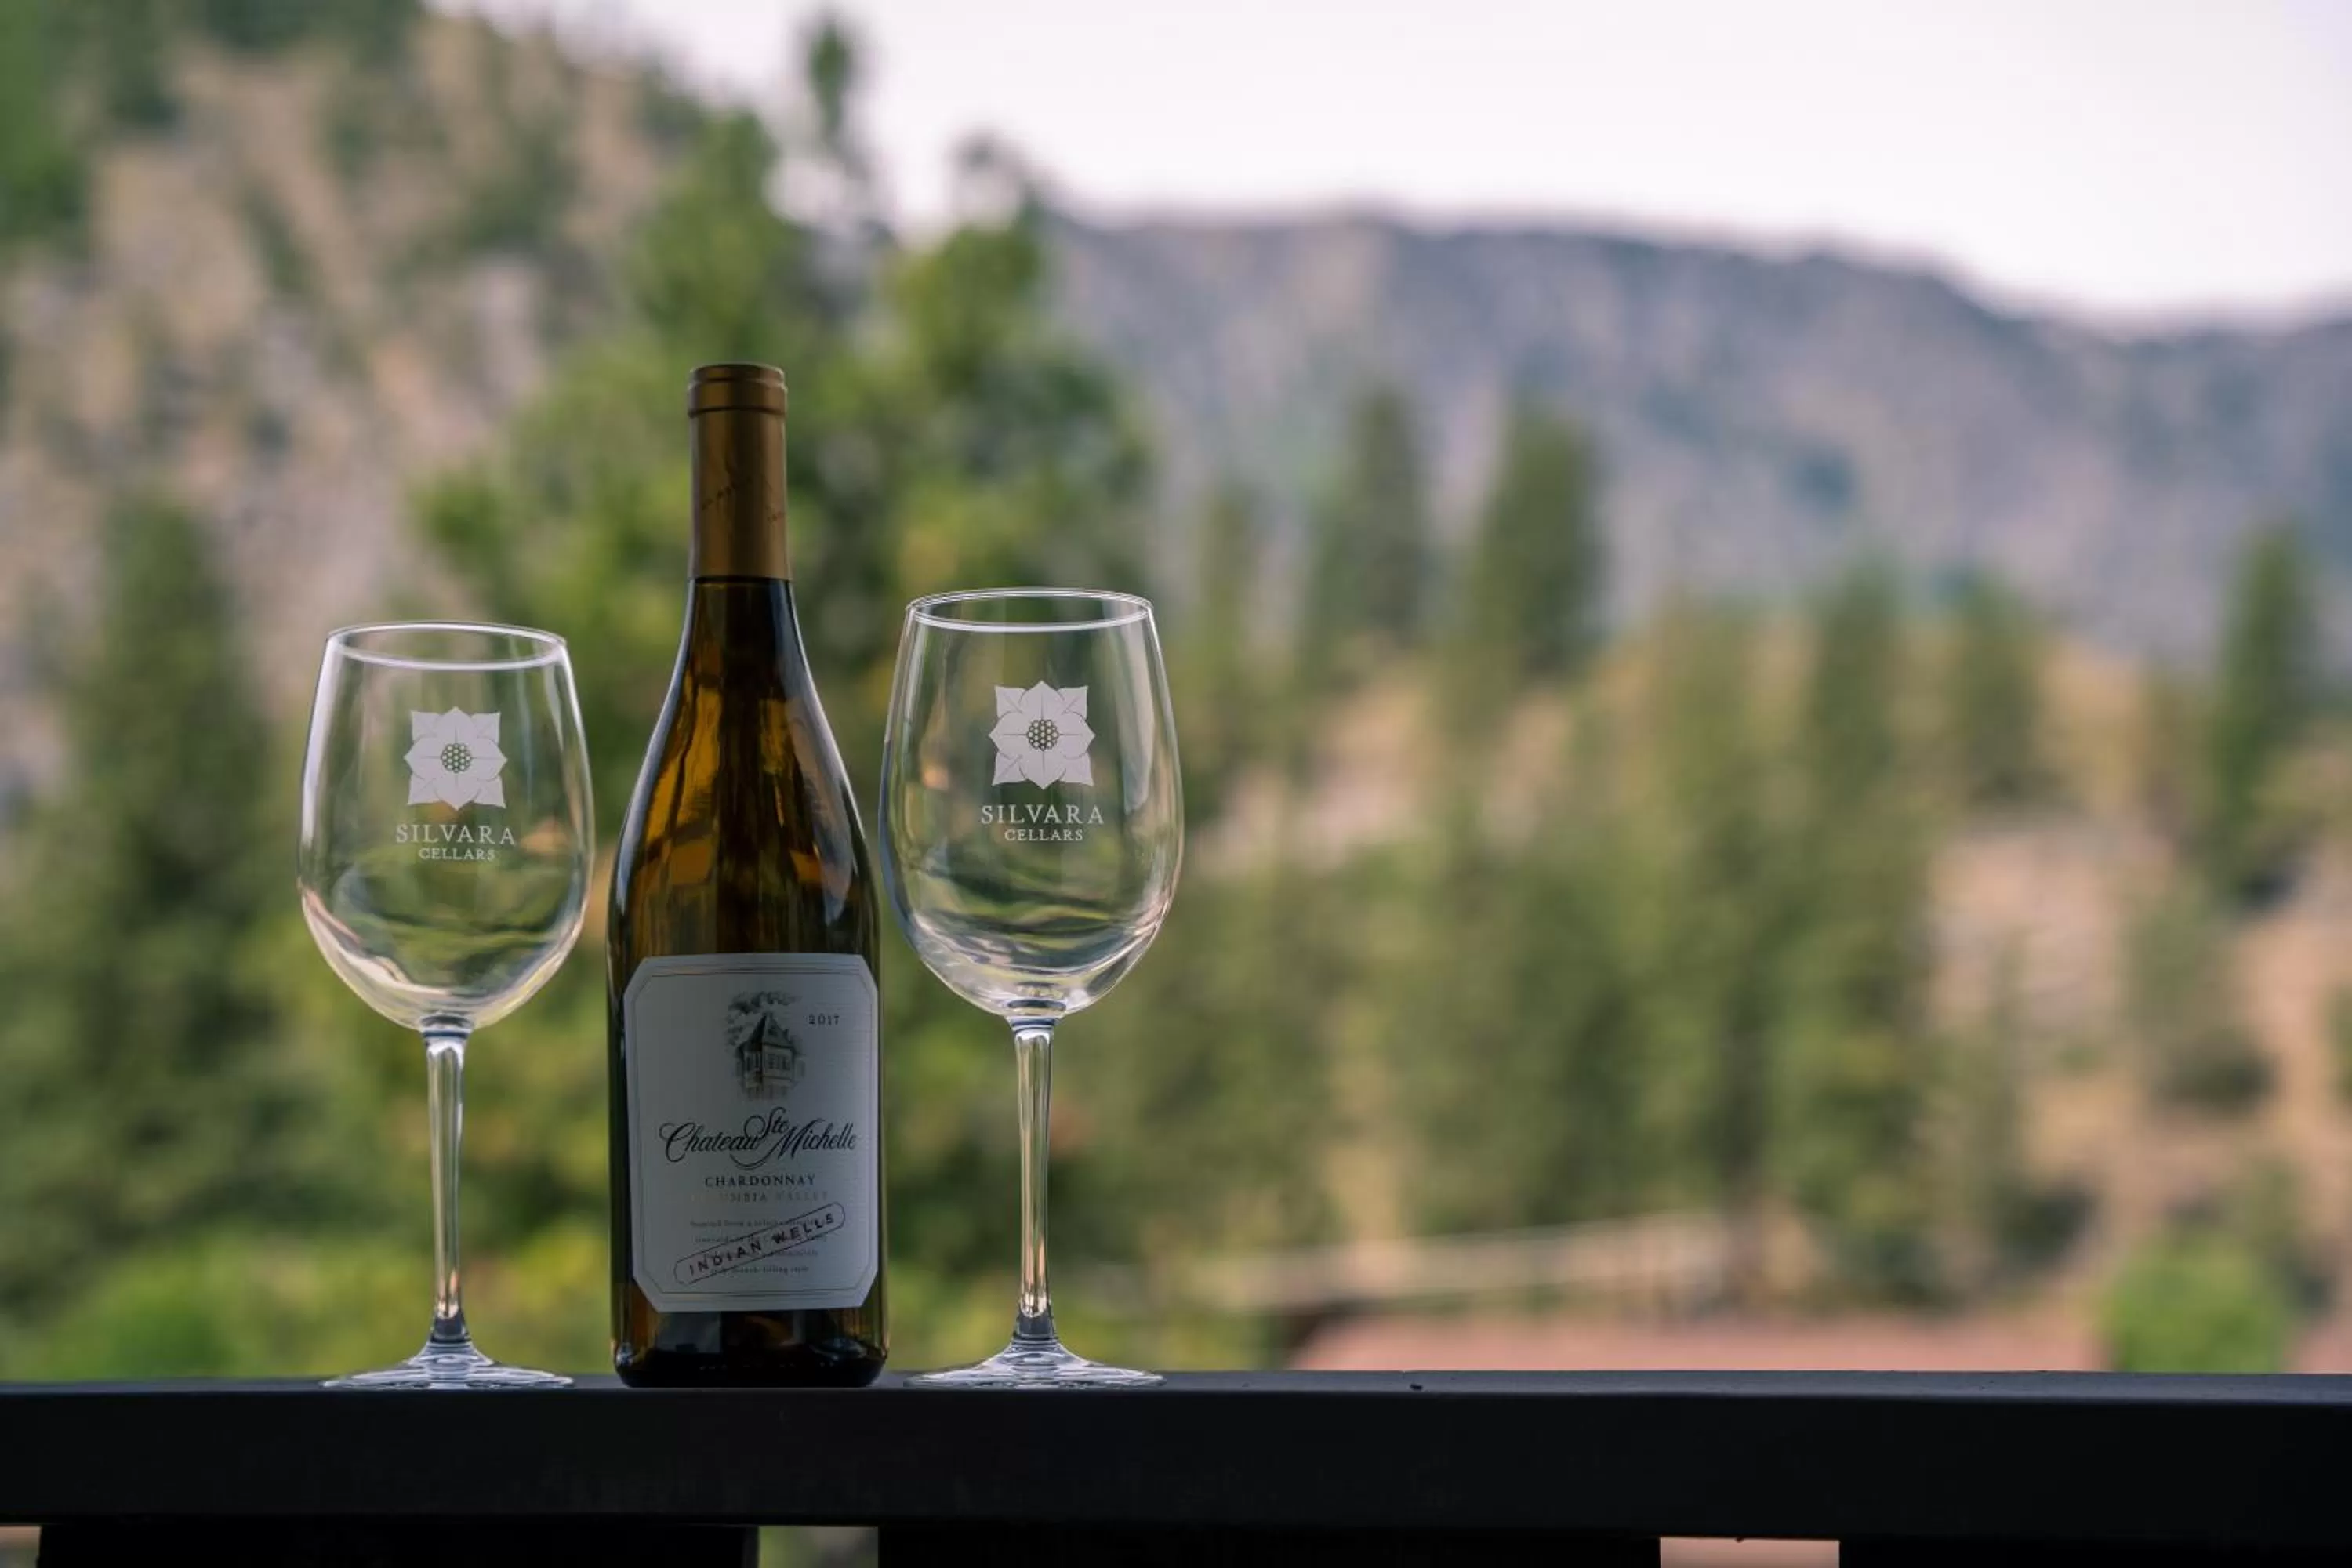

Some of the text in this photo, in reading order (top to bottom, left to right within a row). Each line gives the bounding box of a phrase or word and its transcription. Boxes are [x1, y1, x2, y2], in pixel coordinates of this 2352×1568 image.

[980, 804, 1105, 825] SILVARA
[395, 823, 516, 845] SILVARA
[1004, 829, 1083, 842] CELLARS
[418, 848, 495, 861] CELLARS
[808, 1015, 840, 1025] 2017
[659, 1121, 760, 1163] Chateau
[705, 1176, 815, 1188] CHARDONNAY
[689, 1213, 835, 1276] INDIAN WELLS
